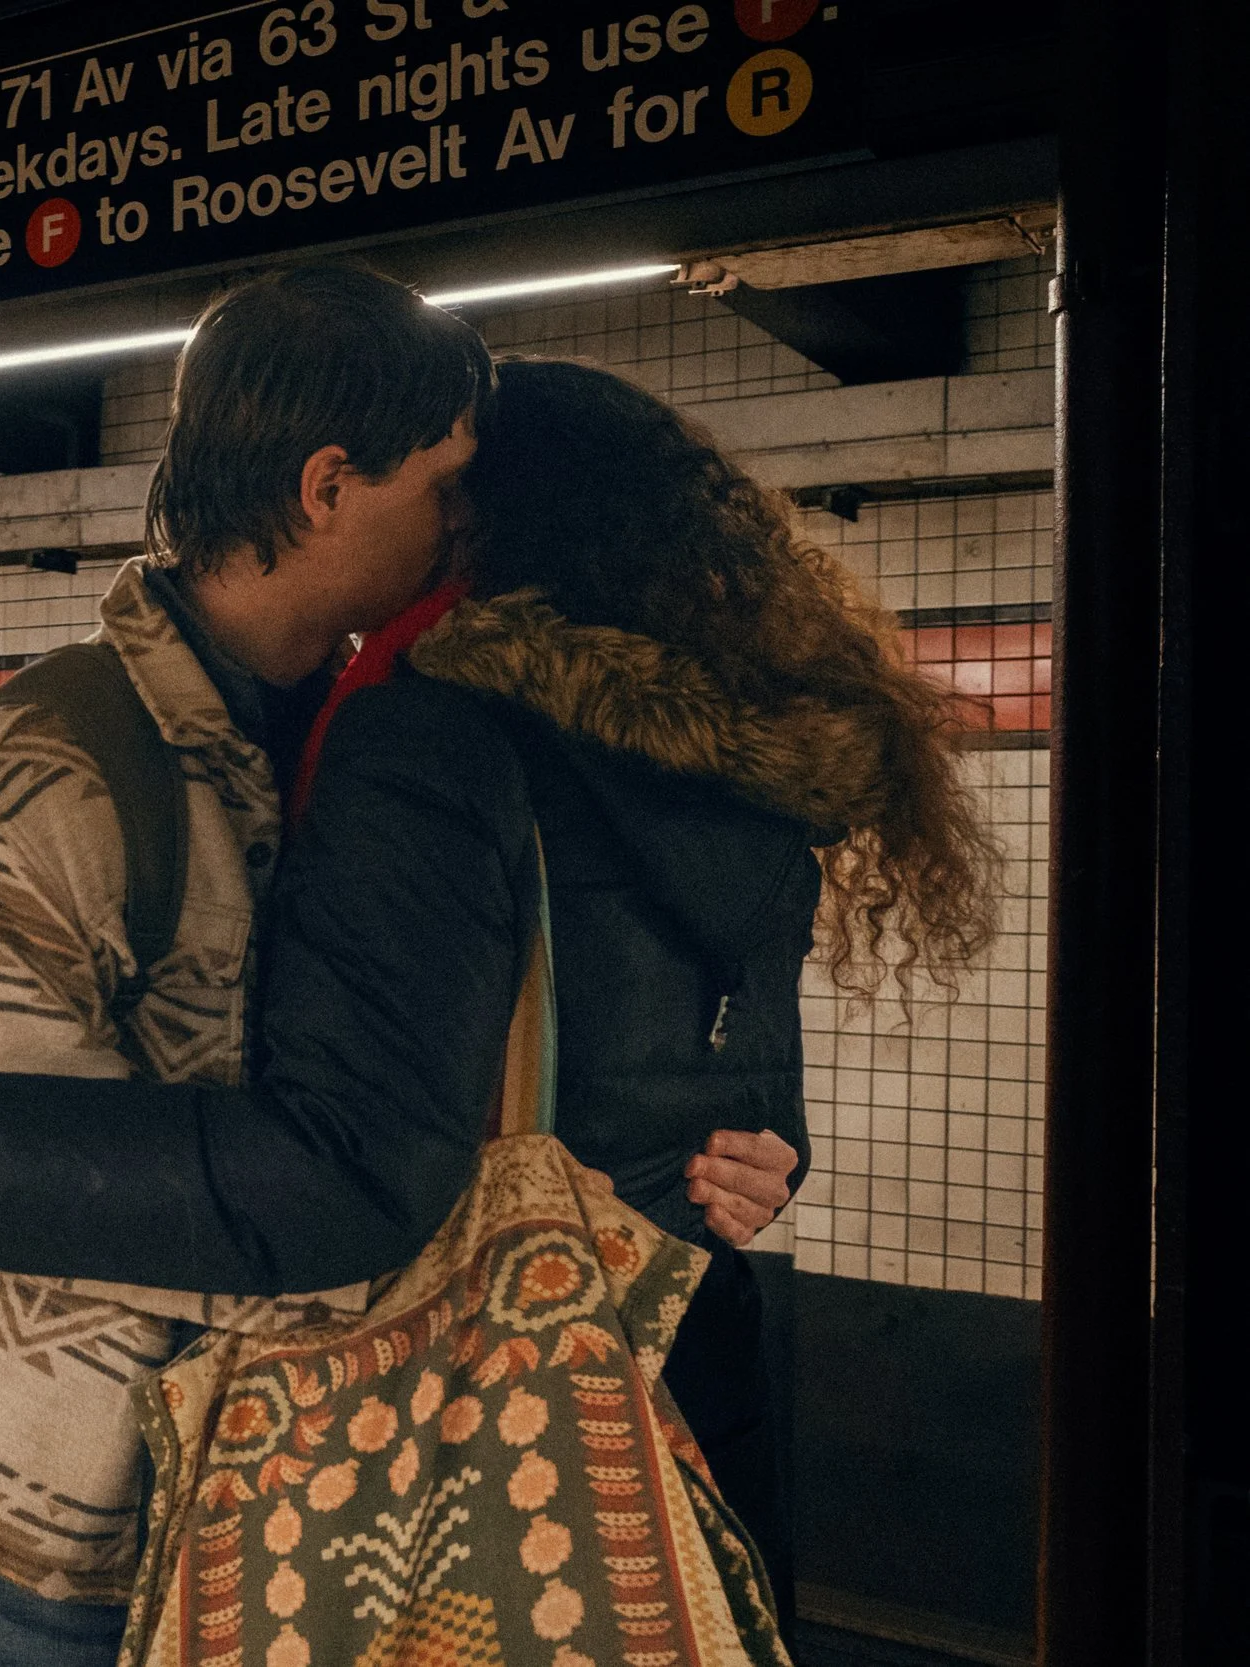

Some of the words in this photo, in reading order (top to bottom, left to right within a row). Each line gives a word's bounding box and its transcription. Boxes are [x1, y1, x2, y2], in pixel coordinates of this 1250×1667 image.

[73, 58, 134, 113] Av
[157, 31, 233, 90] via
[259, 0, 337, 66] 63
[207, 86, 331, 153] Late
[358, 36, 550, 122] nights
[582, 4, 710, 72] use
[42, 212, 65, 253] F
[96, 197, 149, 245] to
[172, 124, 467, 232] Roosevelt
[495, 107, 576, 171] Av
[606, 86, 710, 149] for
[751, 67, 791, 118] R
